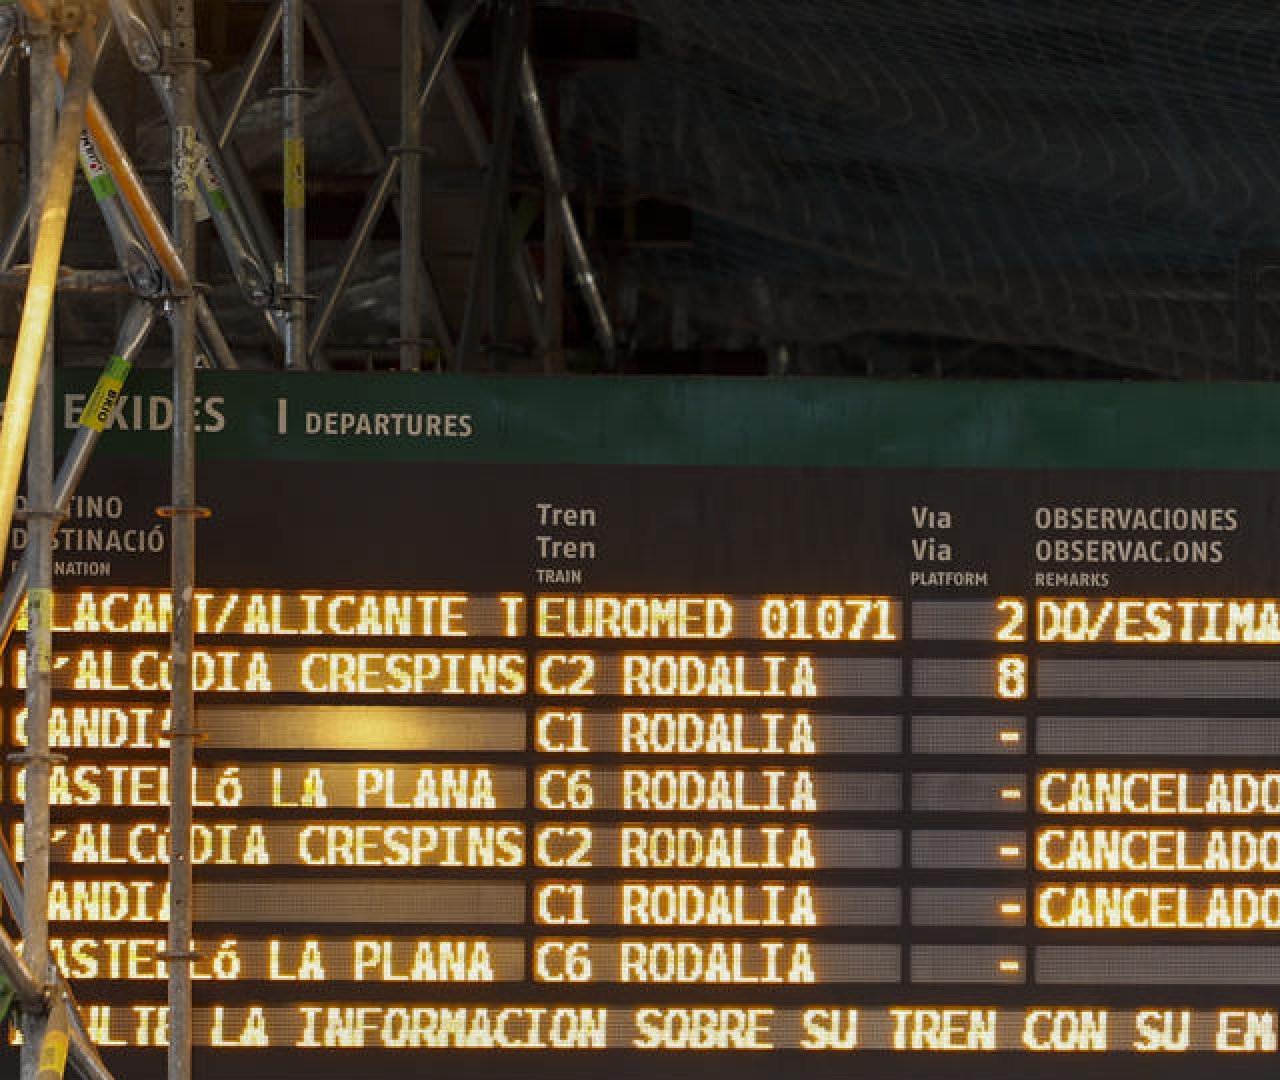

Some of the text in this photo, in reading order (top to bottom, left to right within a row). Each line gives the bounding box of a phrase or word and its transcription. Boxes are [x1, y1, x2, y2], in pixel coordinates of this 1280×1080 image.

[64, 393, 226, 432] EXIDS
[306, 412, 472, 436] DEPARTURES
[537, 504, 594, 526] Tren
[1036, 508, 1236, 530] OBSERVACIONES
[536, 536, 594, 558] Tren
[912, 538, 950, 560] Via
[536, 570, 580, 582] TRAIN
[912, 572, 987, 586] PLATFORM
[1036, 572, 1108, 586] REMARKS
[538, 598, 1024, 640] EUROMED 01071 2
[300, 654, 1024, 698] CRESPINS C2 RODALIA 8
[538, 712, 816, 754] C1 RODALIA
[272, 768, 327, 808] LA
[356, 768, 496, 809] PLANA
[540, 770, 594, 808] C6
[624, 770, 816, 810] RODALIA
[298, 826, 522, 866] CRESPINS
[538, 828, 592, 866] C2
[622, 828, 816, 868] RODALIA
[538, 884, 590, 924] C1
[622, 884, 816, 926] RODALIA
[270, 940, 816, 982] LA PLANA C6 RODALIA
[212, 1008, 268, 1046] LA
[296, 1008, 606, 1048] INFORMACION
[634, 1008, 774, 1048] SOBRE
[800, 1010, 858, 1048] SU
[890, 1010, 996, 1050] TREN
[1022, 1010, 1108, 1050] CON
[1133, 1012, 1190, 1050] SU
[1216, 1012, 1276, 1050] EM
